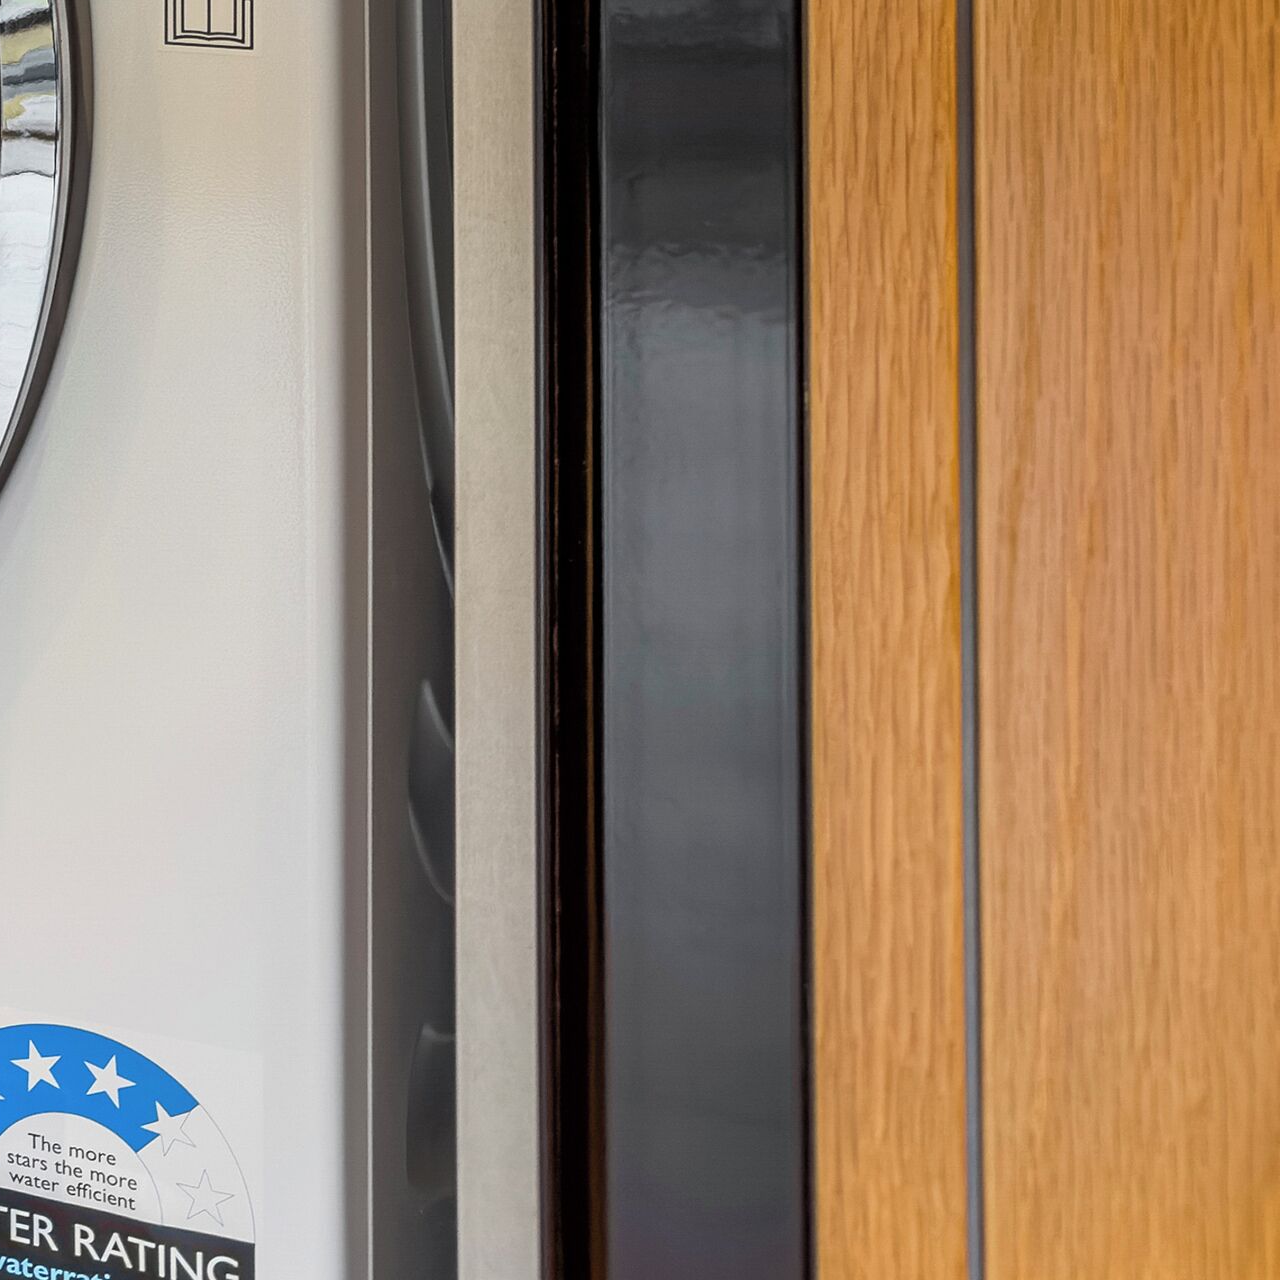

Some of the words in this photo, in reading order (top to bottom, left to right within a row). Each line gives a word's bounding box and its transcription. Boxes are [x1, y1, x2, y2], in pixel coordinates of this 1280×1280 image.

[28, 1132, 62, 1155] The
[69, 1144, 117, 1166] more
[6, 1152, 48, 1171] stars
[55, 1160, 84, 1179] the
[90, 1170, 138, 1191] more
[9, 1171, 60, 1192] water
[66, 1182, 137, 1211] efficient
[73, 1223, 239, 1280] RATING
